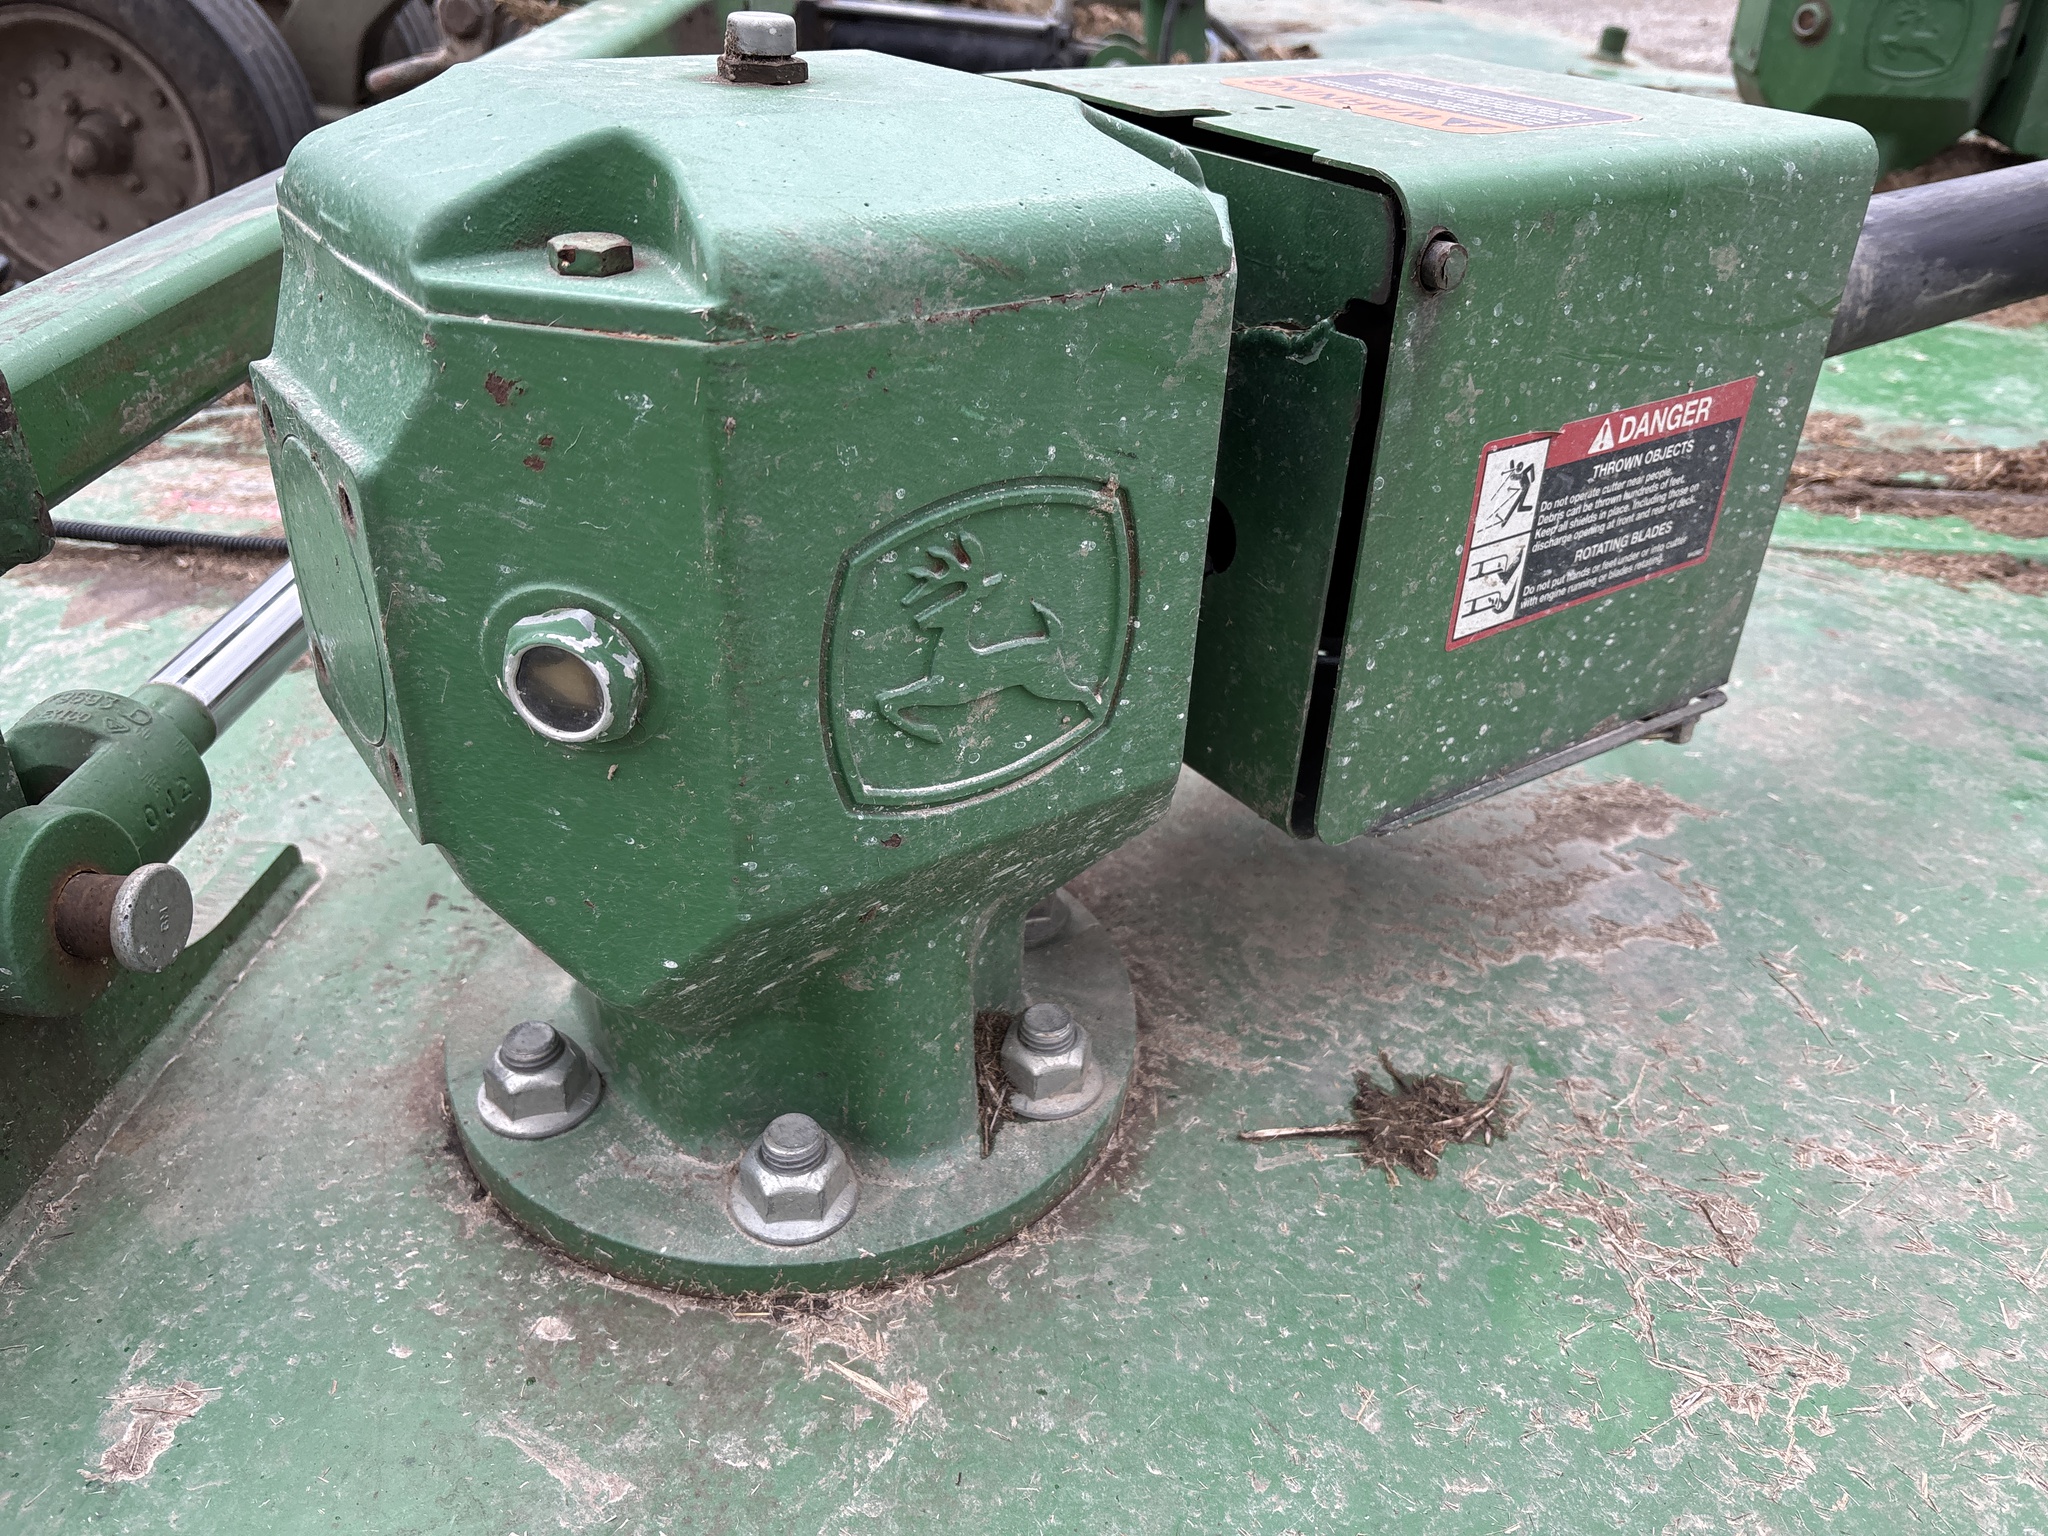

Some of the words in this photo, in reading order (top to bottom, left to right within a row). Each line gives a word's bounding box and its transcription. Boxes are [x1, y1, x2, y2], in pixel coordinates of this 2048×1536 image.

[1245, 80, 1441, 121] WARNING
[1619, 397, 1712, 443] DANGER
[1592, 452, 1643, 479] THROWN
[1643, 438, 1695, 464] OBJECTS
[1534, 522, 1558, 540] Keep
[1557, 520, 1568, 532] all
[1568, 511, 1598, 529] shields
[1598, 508, 1607, 520] in
[1667, 485, 1689, 499] those
[1689, 482, 1699, 493] on
[1537, 508, 1564, 526] Debris
[1565, 504, 1581, 517] can
[1582, 500, 1593, 512] be
[1594, 492, 1622, 508] thrown
[1622, 481, 1659, 501] hundreds
[1659, 478, 1669, 490] of
[1539, 499, 1553, 512] Do
[1553, 495, 1568, 508] not
[1569, 486, 1600, 505] operate
[1601, 479, 1626, 495] cutter
[1626, 474, 1644, 488] near
[1531, 532, 1572, 554] discharge
[1572, 522, 1605, 541] opening
[1606, 519, 1615, 530] at
[1615, 513, 1635, 527] front
[1635, 508, 1650, 521] and
[1650, 503, 1667, 516] rear
[1667, 500, 1676, 511] of
[1573, 533, 1629, 563] ROTATING
[1630, 520, 1673, 545] BLADES
[1519, 594, 1538, 609] with
[1538, 585, 1566, 605] engine
[1567, 575, 1597, 594] running
[1597, 573, 1607, 583] or
[1607, 563, 1633, 580] blades
[1522, 583, 1535, 596] Do
[1536, 579, 1550, 592] not
[1550, 574, 1565, 589] put
[1591, 563, 1600, 574] or
[1601, 556, 1617, 570] feet
[1617, 550, 1640, 565] under
[1640, 547, 1649, 558] or
[1649, 542, 1664, 554] into
